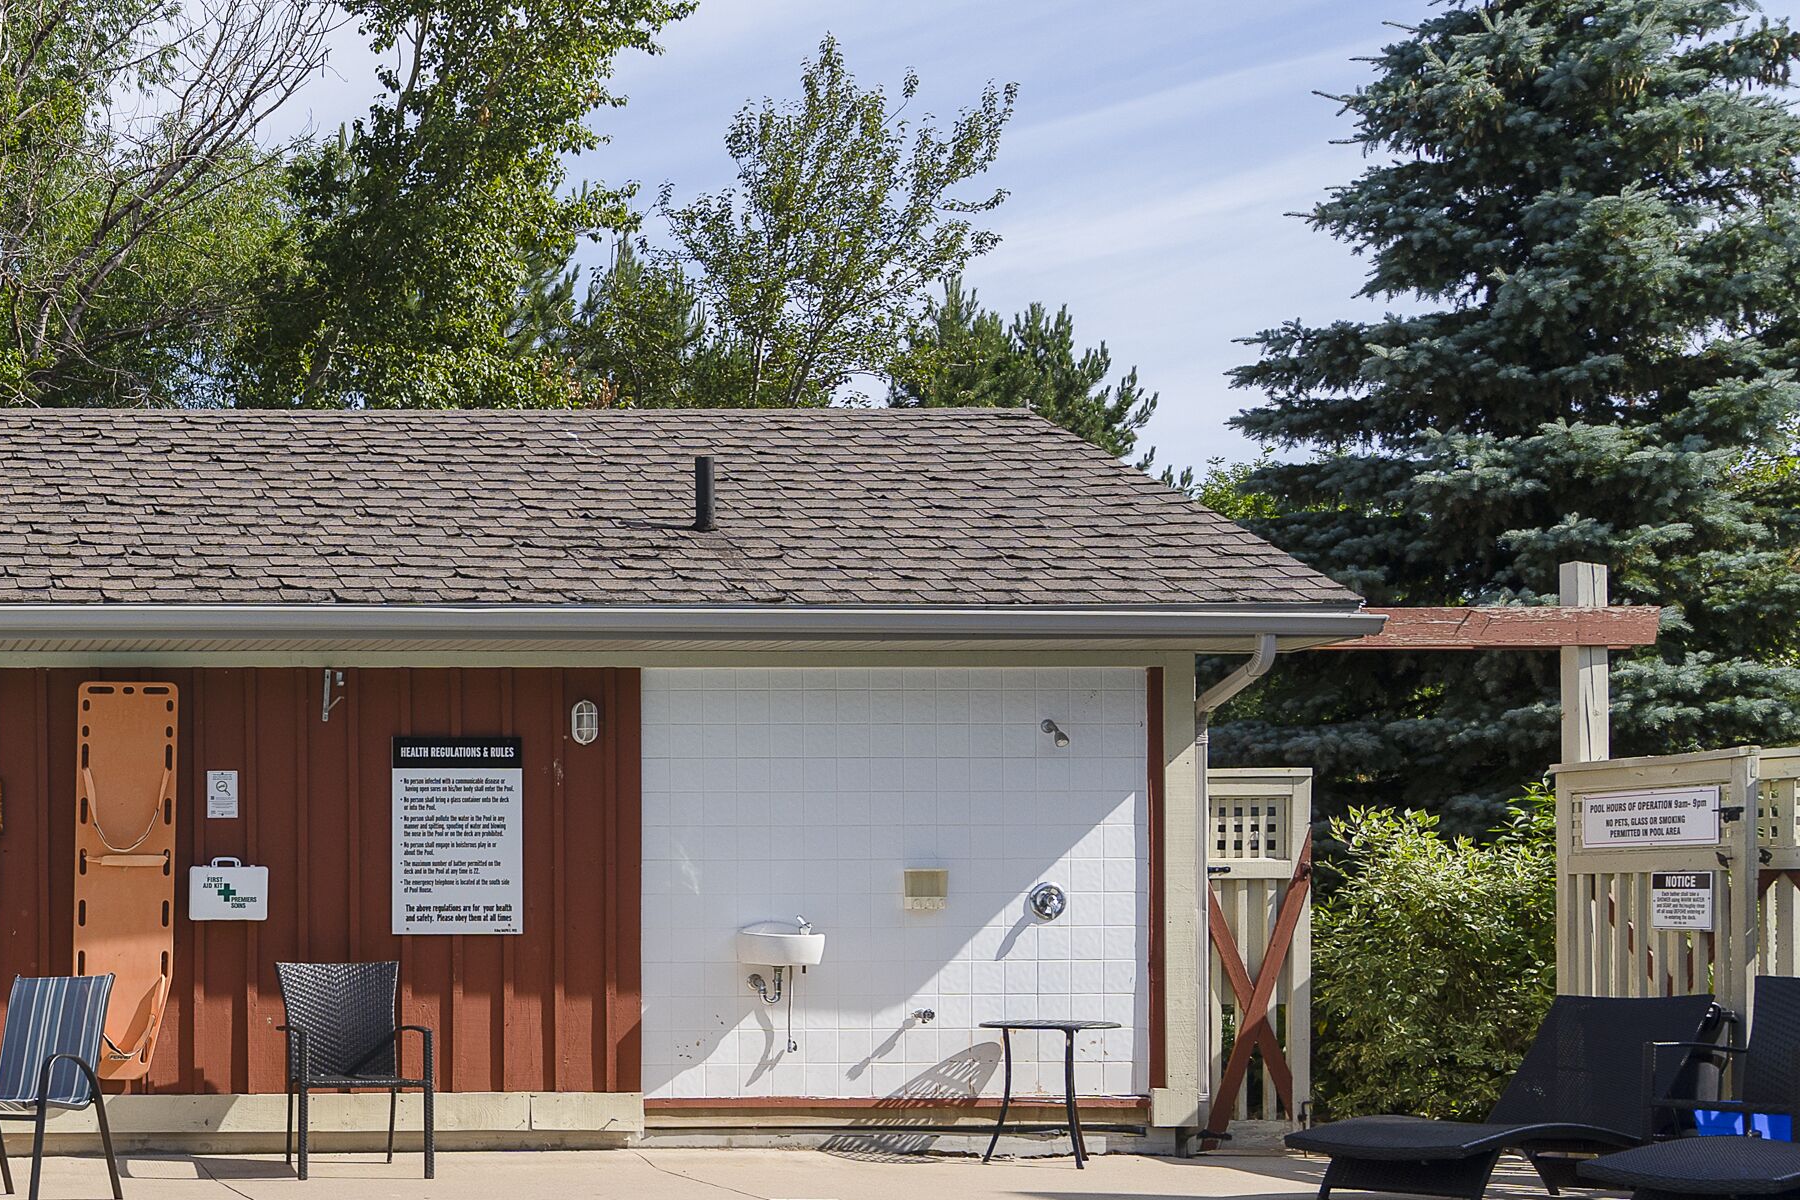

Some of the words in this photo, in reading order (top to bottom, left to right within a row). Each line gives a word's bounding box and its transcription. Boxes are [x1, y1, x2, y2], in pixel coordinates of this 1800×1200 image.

[400, 746, 429, 757] HEALTH
[430, 746, 481, 757] REGULATIONS
[482, 746, 489, 757] &
[490, 746, 515, 757] RULES
[405, 785, 419, 793] having
[463, 785, 473, 793] body
[1589, 804, 1605, 813] POOL
[1606, 802, 1626, 812] HOURS
[1628, 802, 1636, 811] OF
[1637, 800, 1673, 811] OPERATION
[1692, 798, 1707, 810] 9pm
[435, 815, 449, 823] pollute
[1606, 819, 1613, 827] NO
[1614, 818, 1630, 827] PETS,
[1630, 817, 1648, 826] GLASS
[1650, 816, 1658, 825] OR
[1659, 815, 1686, 824] SMOKING
[446, 823, 464, 831] spouting
[490, 823, 506, 831] blowing
[1610, 829, 1640, 838] PERMITTED
[1642, 828, 1648, 836] IN
[1649, 828, 1664, 836] POOL
[1666, 827, 1681, 835] AREA
[467, 860, 487, 868] permitted
[434, 879, 455, 887] telephone
[1665, 875, 1696, 887] NOTICE
[406, 904, 415, 912] The
[416, 904, 432, 912] above
[432, 904, 462, 913] regulations
[472, 904, 480, 912] for
[495, 904, 512, 912] health
[406, 914, 415, 922] and
[416, 914, 434, 923] safety.
[436, 914, 454, 922] Please
[455, 914, 467, 923] obey
[469, 914, 482, 922] them
[483, 914, 488, 922] at
[497, 914, 512, 922] times
